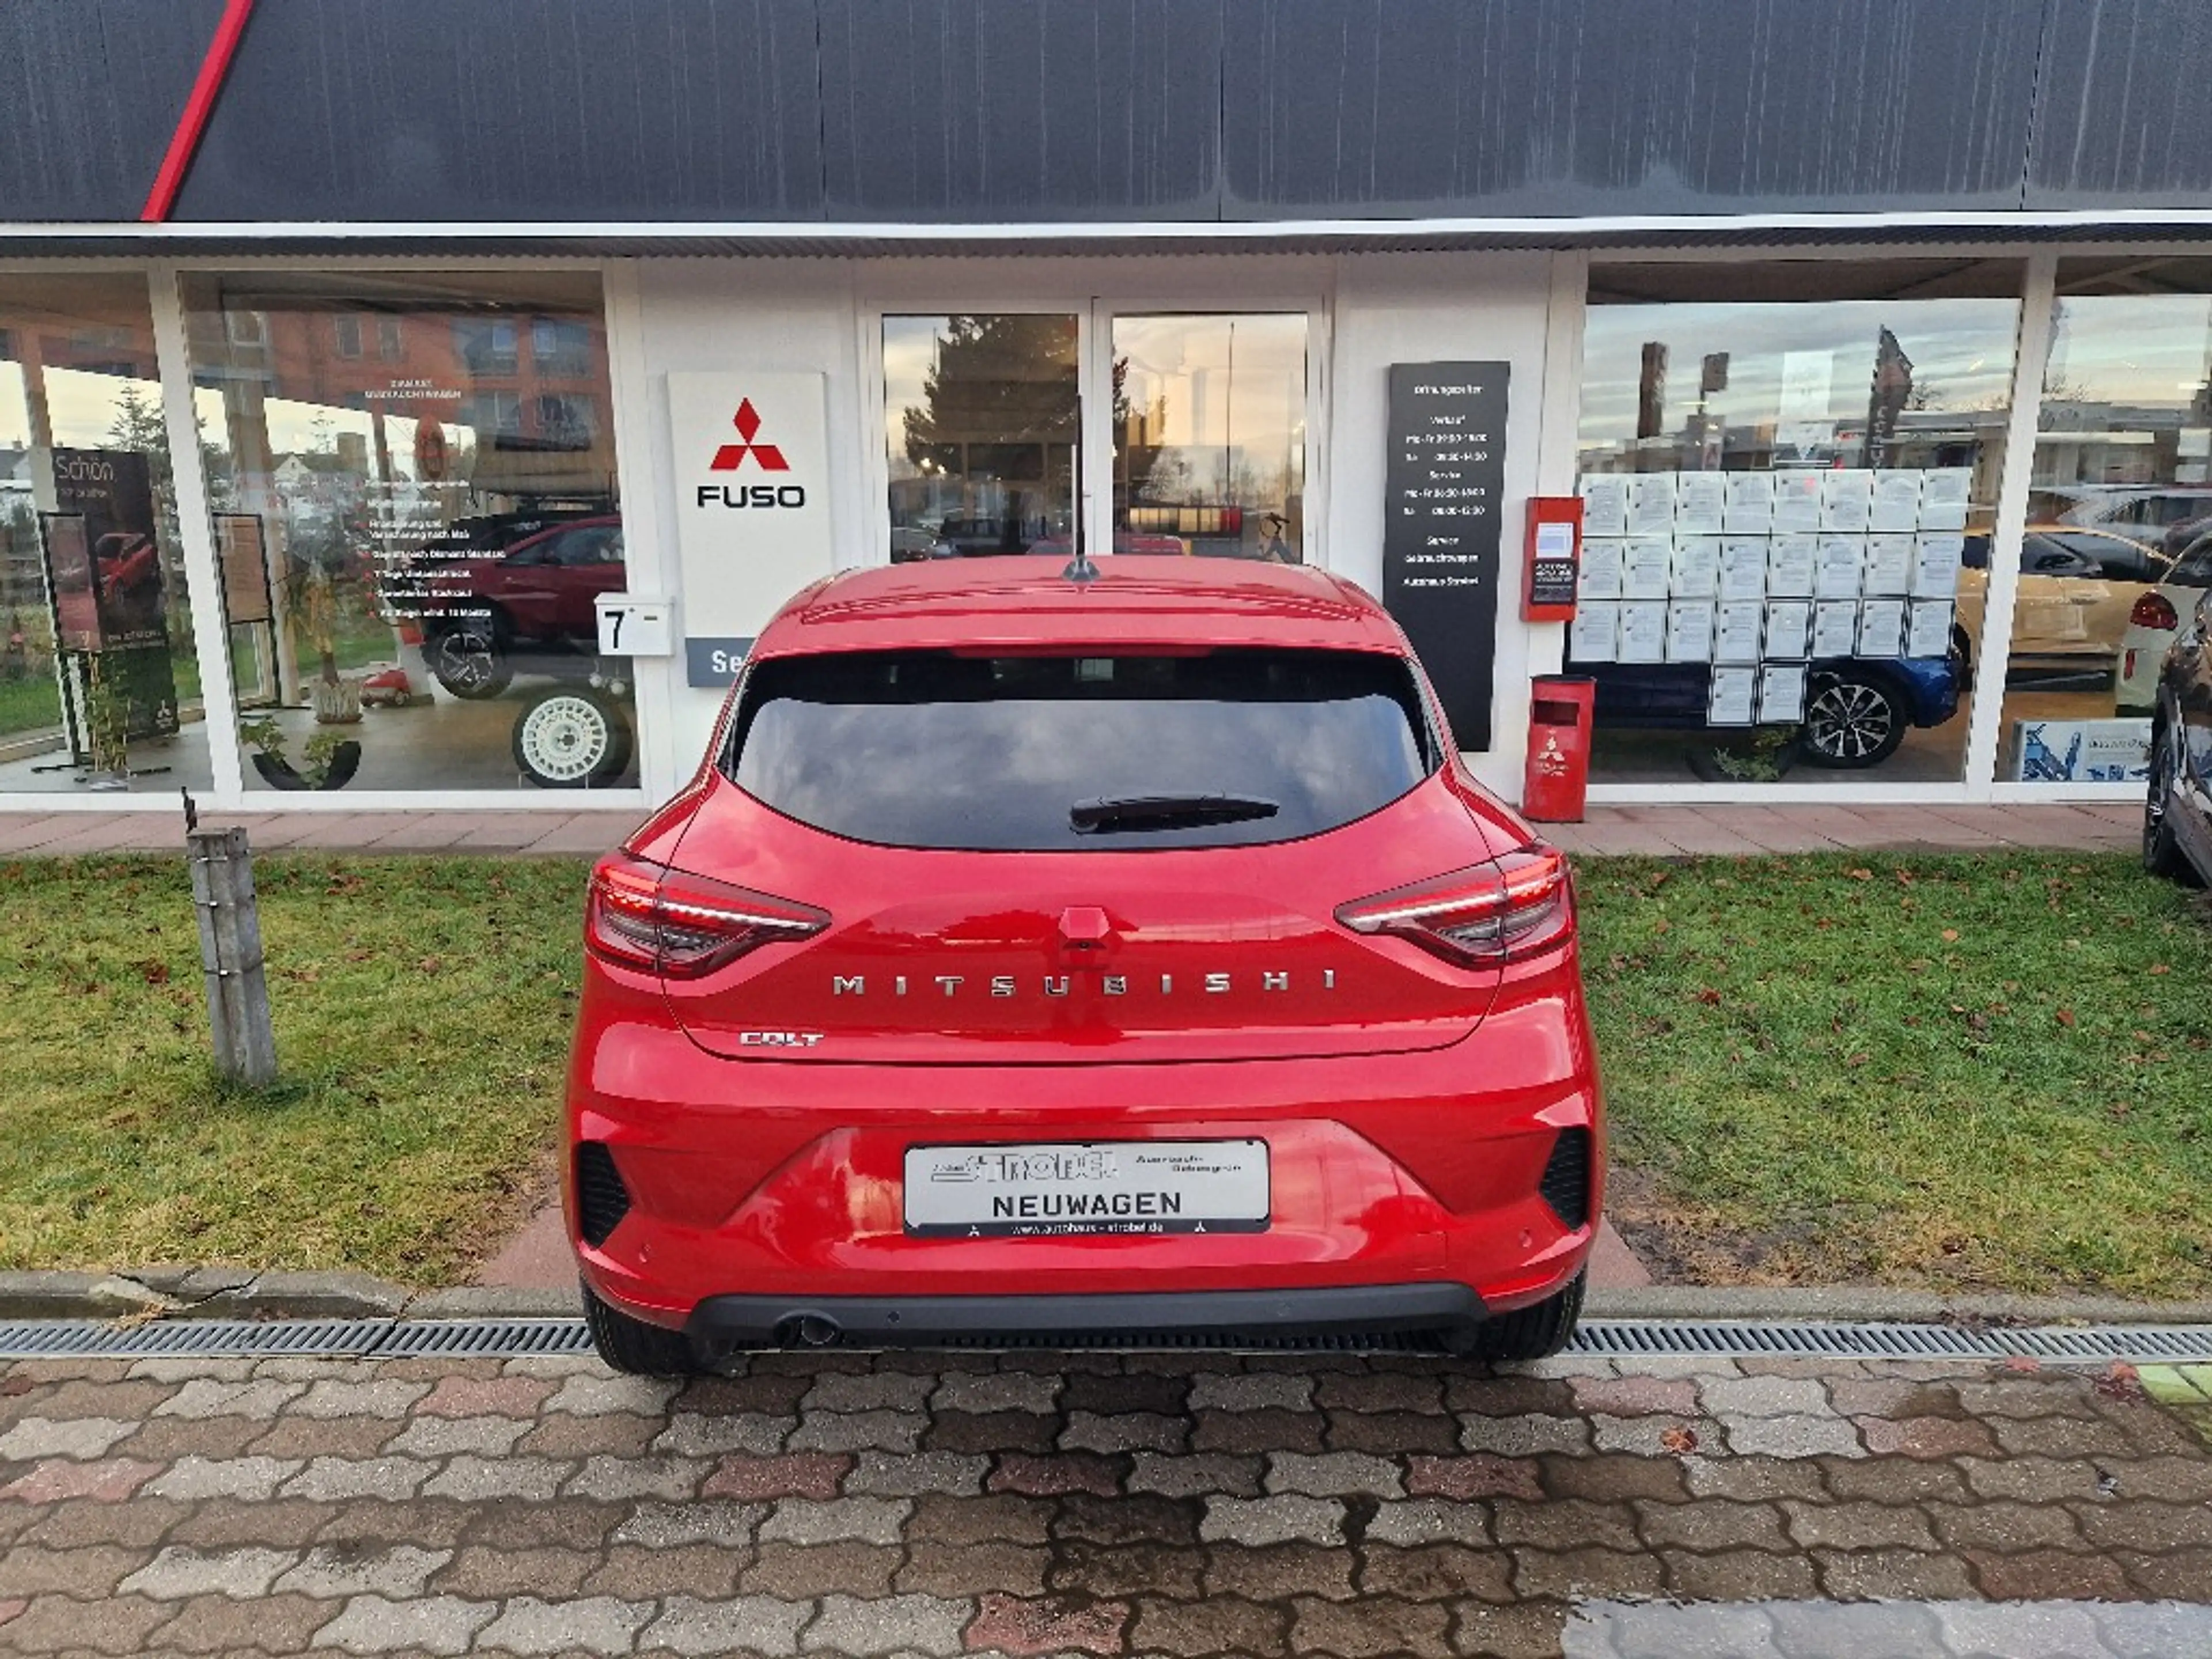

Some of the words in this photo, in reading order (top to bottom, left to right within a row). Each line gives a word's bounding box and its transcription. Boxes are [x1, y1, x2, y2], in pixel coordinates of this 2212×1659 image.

[697, 486, 805, 508] FUSO
[604, 611, 625, 649] 7
[833, 969, 1334, 997] MITSUBISHI
[740, 1032, 824, 1047] COLT
[993, 1192, 1181, 1217] NEUWAGEN
